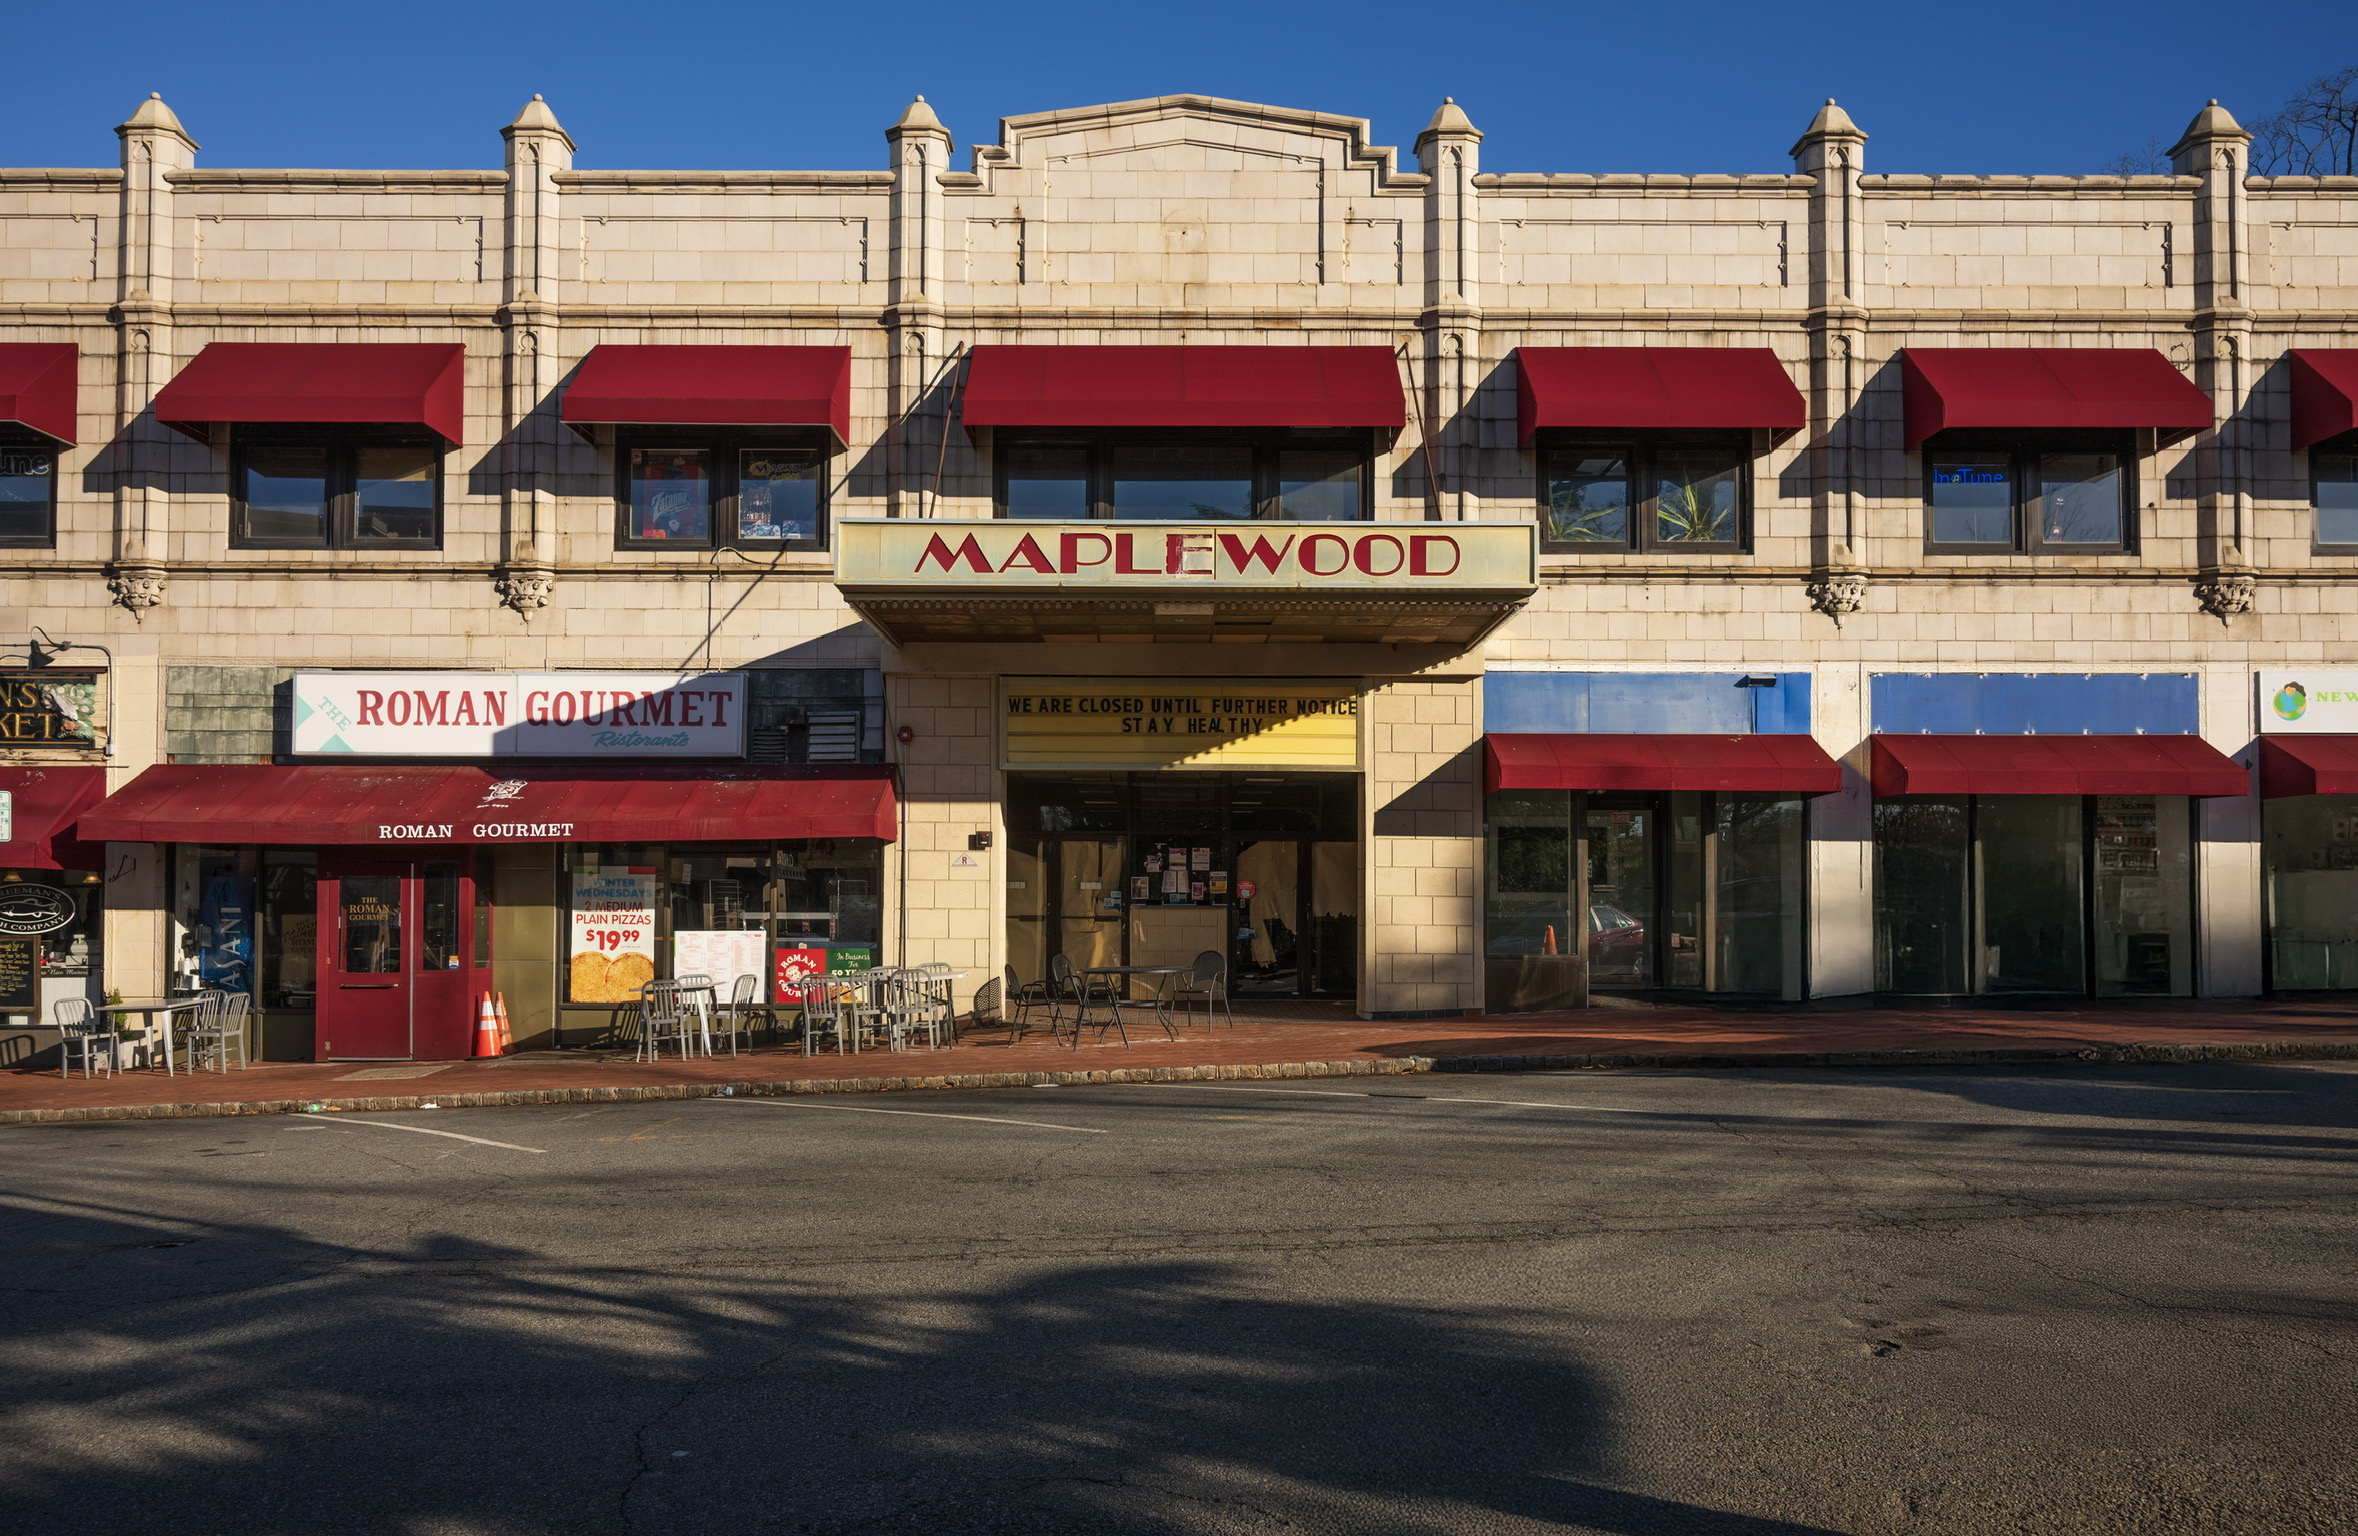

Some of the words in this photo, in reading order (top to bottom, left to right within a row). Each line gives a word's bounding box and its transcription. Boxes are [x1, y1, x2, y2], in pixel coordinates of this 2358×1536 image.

[914, 532, 1460, 576] MAPLEWOOD
[357, 690, 508, 726] ROMAN
[525, 690, 732, 727] GOURMET
[1009, 698, 1032, 712] WE
[1039, 698, 1072, 713] ARE
[1079, 698, 1143, 713] CLOSED
[1151, 699, 1201, 713] UNTIL
[1212, 699, 1287, 714] FURTHER
[1297, 700, 1357, 715] NOTICE
[318, 697, 352, 732] THE
[1122, 718, 1174, 733] STAY
[1188, 718, 1263, 733] HEALTHY
[591, 730, 690, 748] Ristorante
[379, 825, 453, 839] ROMAN
[472, 823, 574, 837] GOURMET
[962, 856, 968, 865] R
[594, 878, 636, 888] WINTER
[361, 896, 378, 904] THE
[576, 888, 652, 898] WEDNESDAYS
[350, 904, 389, 914] ROMAN
[584, 901, 592, 912] 2
[596, 901, 644, 912] MEDIUM
[11, 915, 64, 931] COMPANY
[576, 914, 608, 925] PLAIN
[611, 914, 652, 925] PIZZAS
[213, 907, 246, 989] ASANI
[780, 954, 817, 969] ROMAN
